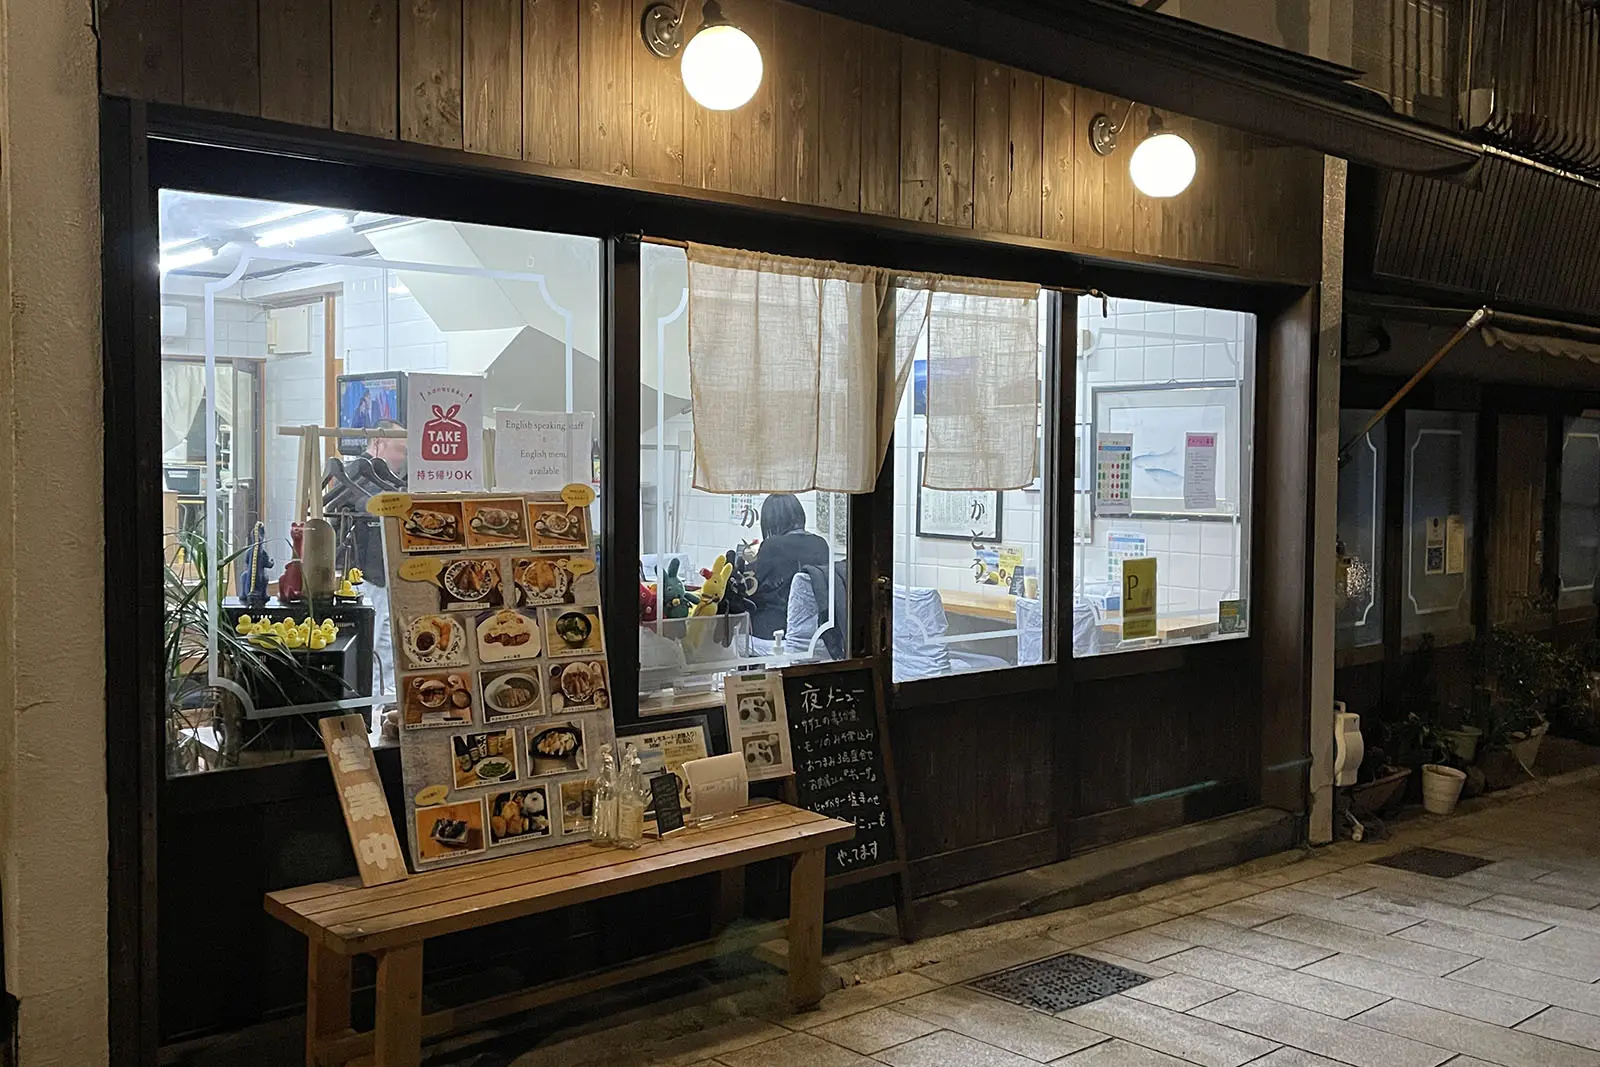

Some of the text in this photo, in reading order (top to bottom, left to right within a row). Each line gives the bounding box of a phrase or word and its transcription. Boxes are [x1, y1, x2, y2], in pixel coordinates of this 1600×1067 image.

[505, 419, 532, 431] English
[533, 421, 566, 432] speaking
[427, 429, 462, 443] TAKE
[430, 443, 459, 455] OUT
[520, 449, 547, 460] English
[416, 469, 473, 481] 持ち帰りOK
[1126, 574, 1139, 600] P
[800, 683, 865, 713] 夜メニュー
[331, 734, 398, 870] 営業中
[836, 840, 879, 867] やってます
